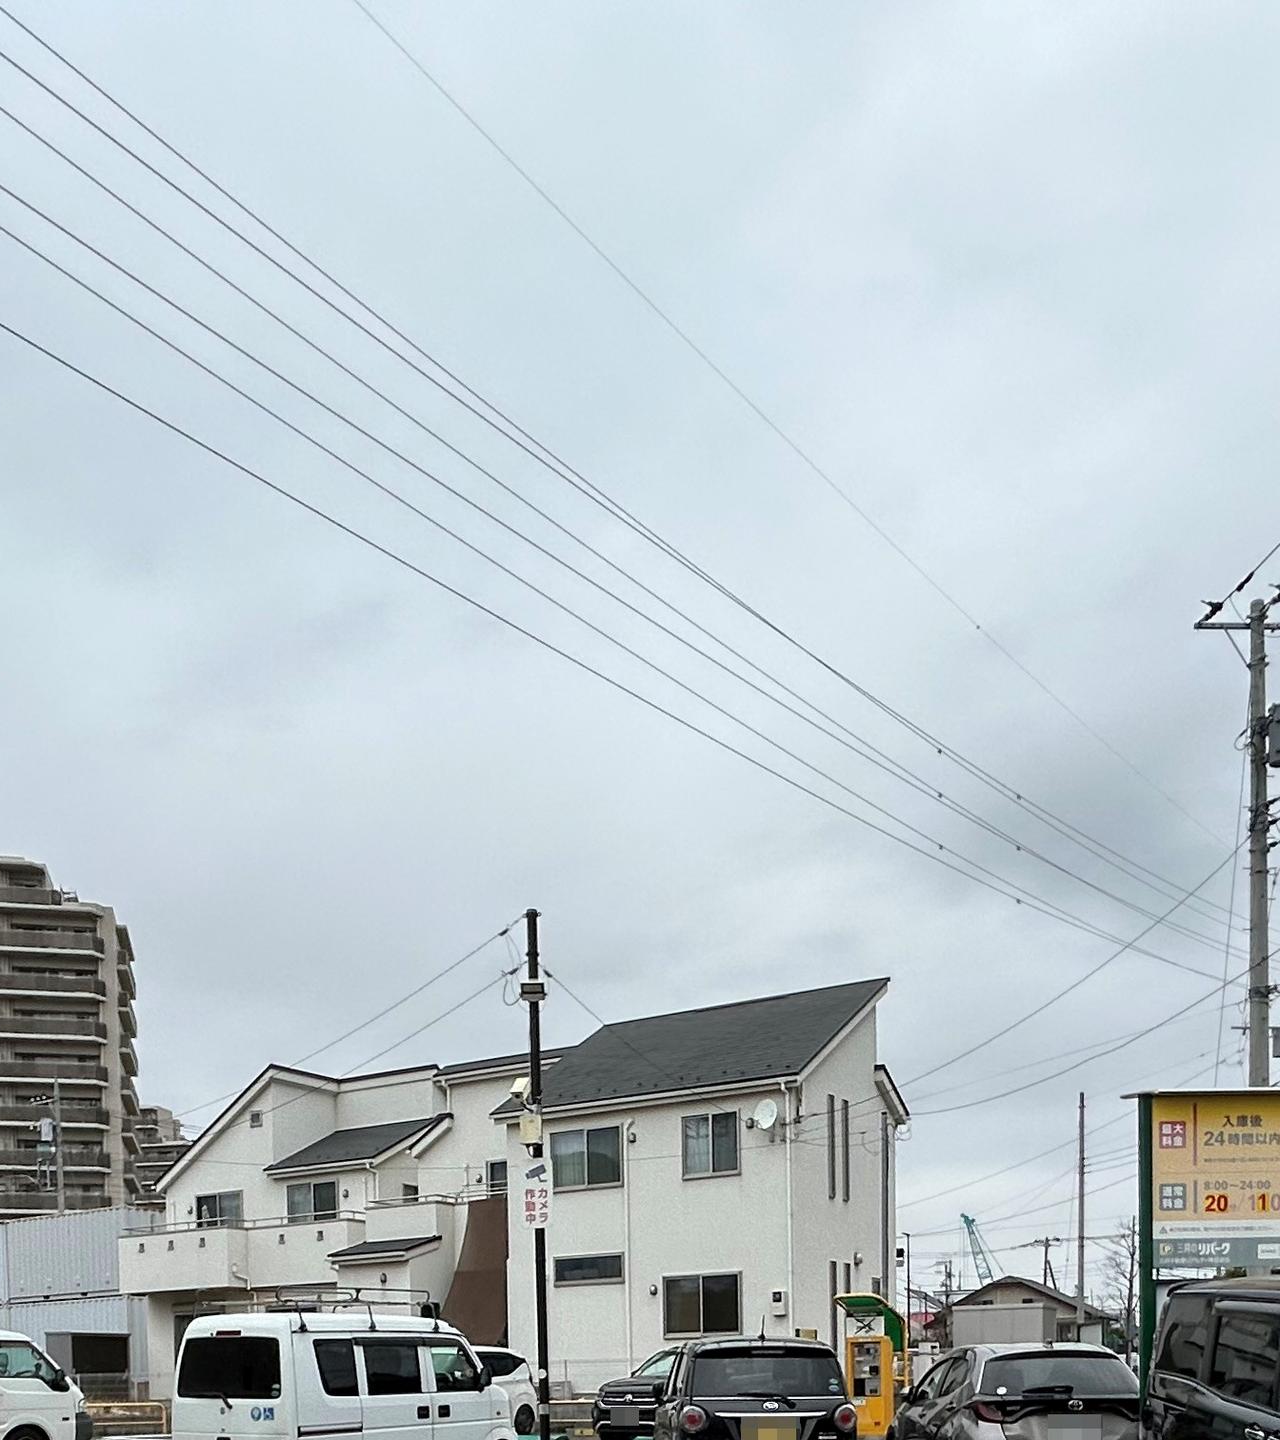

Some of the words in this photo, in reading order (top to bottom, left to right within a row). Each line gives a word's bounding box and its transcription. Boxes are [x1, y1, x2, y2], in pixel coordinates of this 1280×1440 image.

[1222, 1115, 1263, 1128] 入庫後
[1203, 1131, 1280, 1147] 24時間以内
[538, 1187, 548, 1223] カメラ
